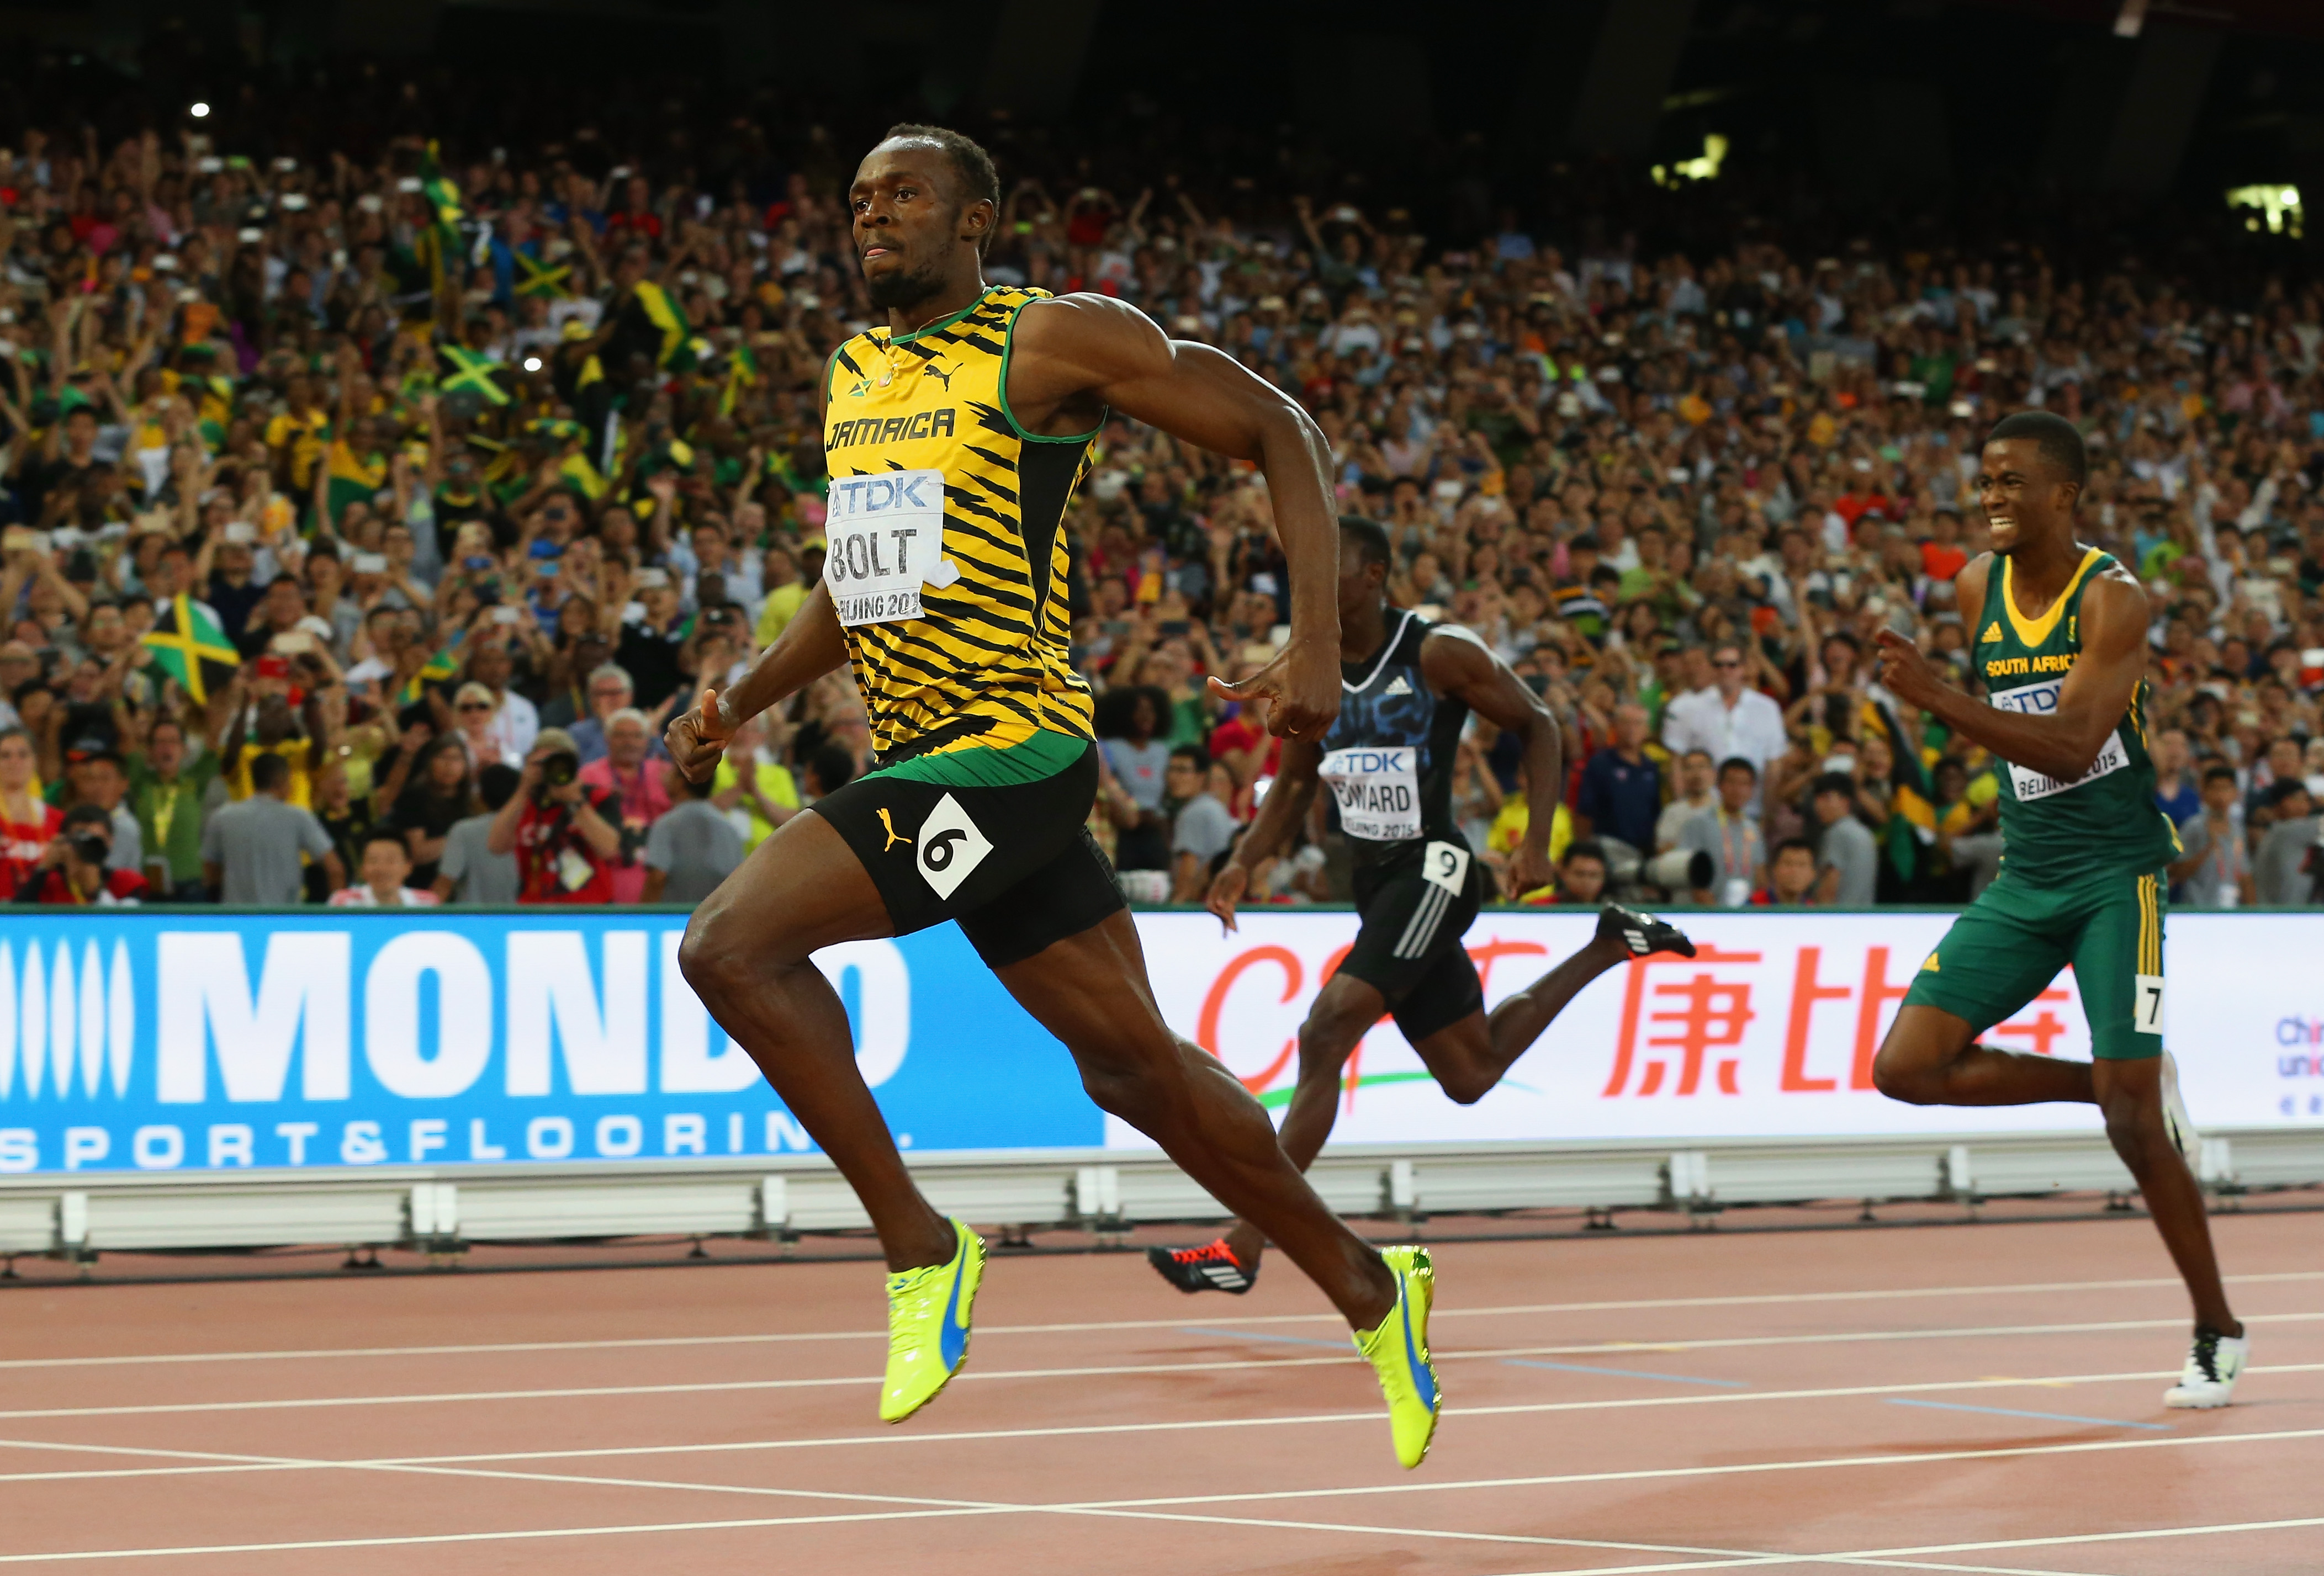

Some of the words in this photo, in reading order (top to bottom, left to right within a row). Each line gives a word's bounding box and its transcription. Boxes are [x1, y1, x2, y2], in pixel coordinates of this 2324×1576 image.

[826, 408, 956, 453] JAMAICA
[840, 476, 928, 514] TDK
[831, 529, 917, 583] BOLT
[839, 595, 884, 622] IJING
[887, 592, 924, 617] 201
[1986, 656, 2030, 678] SOUTH
[2013, 684, 2061, 713] TD
[1346, 752, 1403, 773] TDK
[2018, 776, 2064, 796] BEIJI
[2084, 752, 2117, 777] 015
[922, 828, 968, 872] 6
[1440, 850, 1457, 878] 9
[1601, 942, 2073, 1097] 康比
[2147, 987, 2161, 1025] 7
[2276, 1014, 2324, 1046] Chi
[2278, 1055, 2324, 1078] uni
